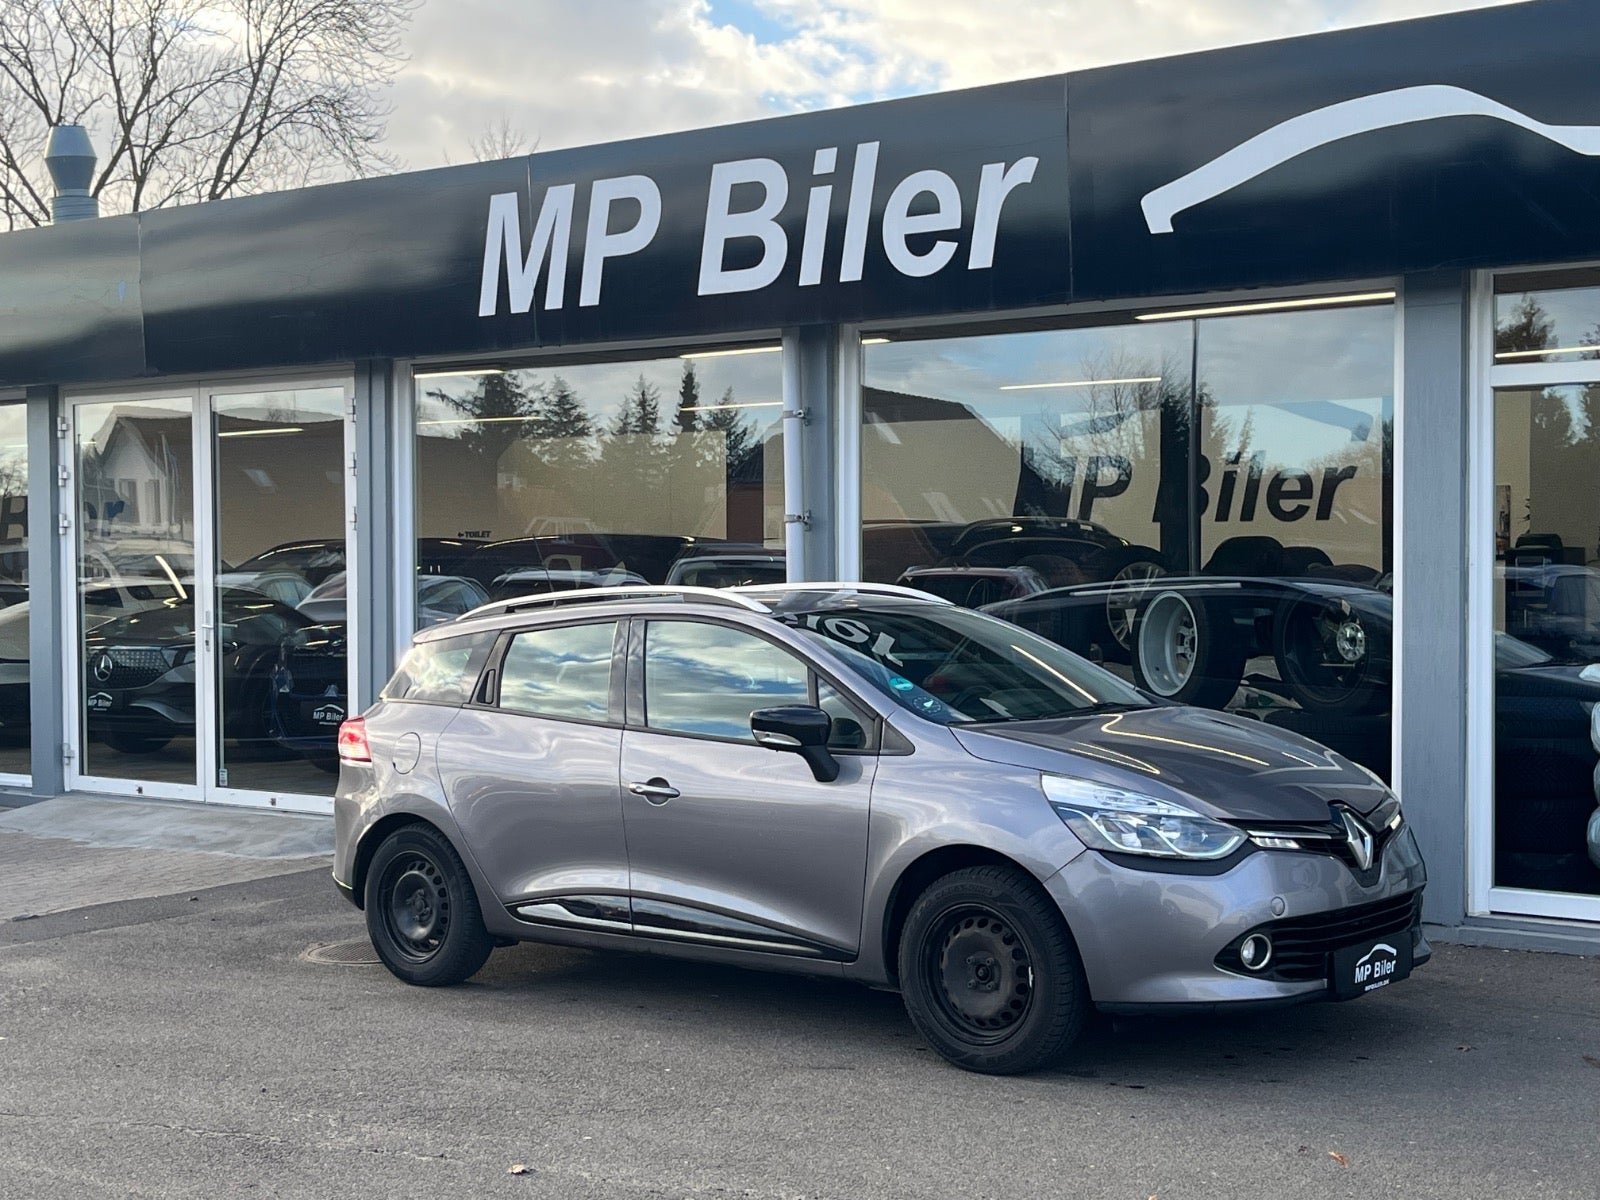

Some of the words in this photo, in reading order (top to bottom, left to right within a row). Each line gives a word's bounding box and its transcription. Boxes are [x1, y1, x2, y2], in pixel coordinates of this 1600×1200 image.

[478, 174, 662, 317] MP
[698, 141, 1039, 295] Biler
[465, 530, 491, 538] TOILET
[312, 711, 325, 720] MP
[326, 712, 344, 721] Biler
[1354, 964, 1372, 984] MP
[1373, 958, 1397, 978] Biler
